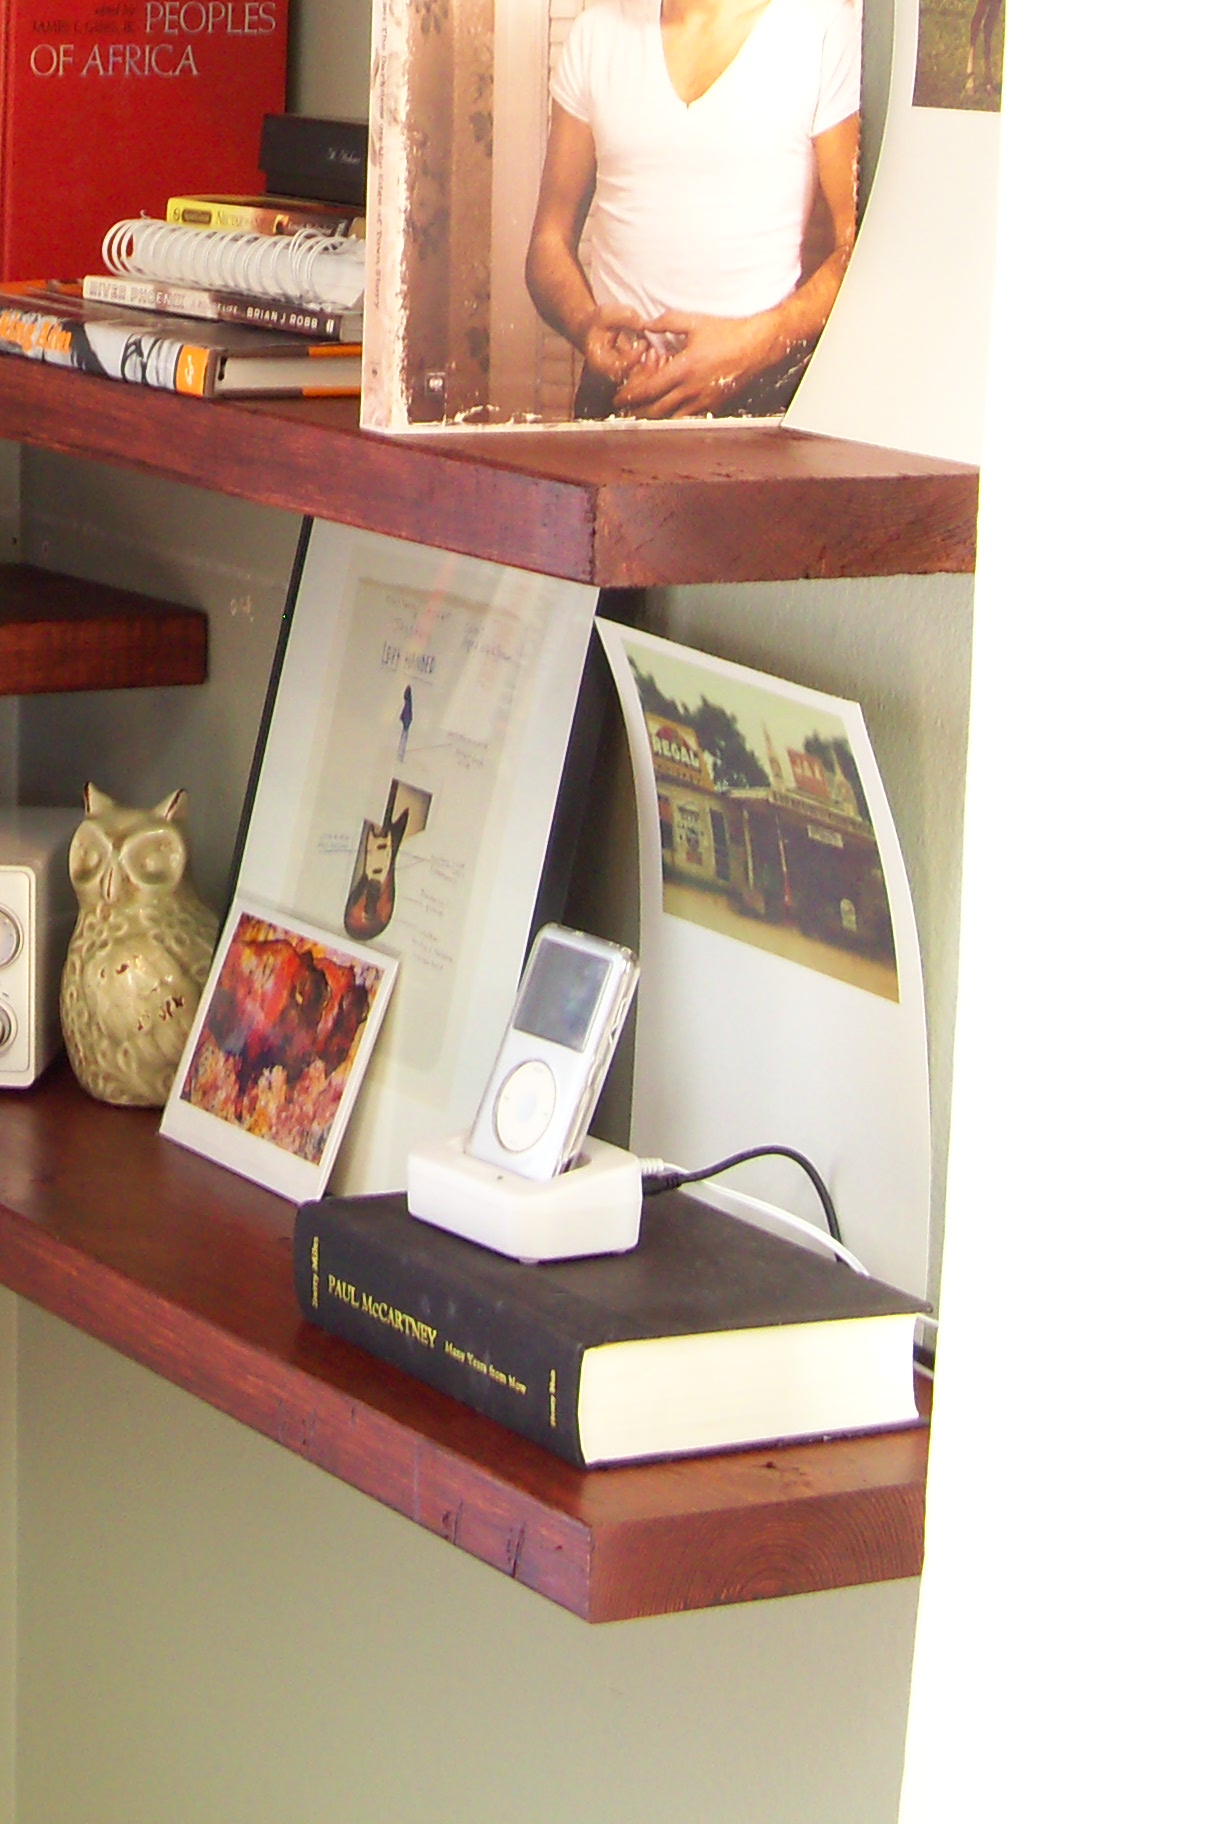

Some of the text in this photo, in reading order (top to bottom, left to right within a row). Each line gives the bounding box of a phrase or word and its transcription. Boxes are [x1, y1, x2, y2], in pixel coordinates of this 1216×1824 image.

[145, 0, 277, 36] PEOPLES
[29, 43, 200, 77] OF AFRICA
[376, 173, 384, 206] Edge
[375, 209, 383, 226] of
[374, 230, 383, 265] Town
[372, 268, 381, 310] Story
[246, 305, 319, 329] BRIAN J ROBB
[37, 321, 72, 354] Aim
[653, 736, 701, 768] REGAL
[327, 1273, 438, 1349] PAUL McCARTNEY
[444, 1339, 527, 1395] Many Years from Now
